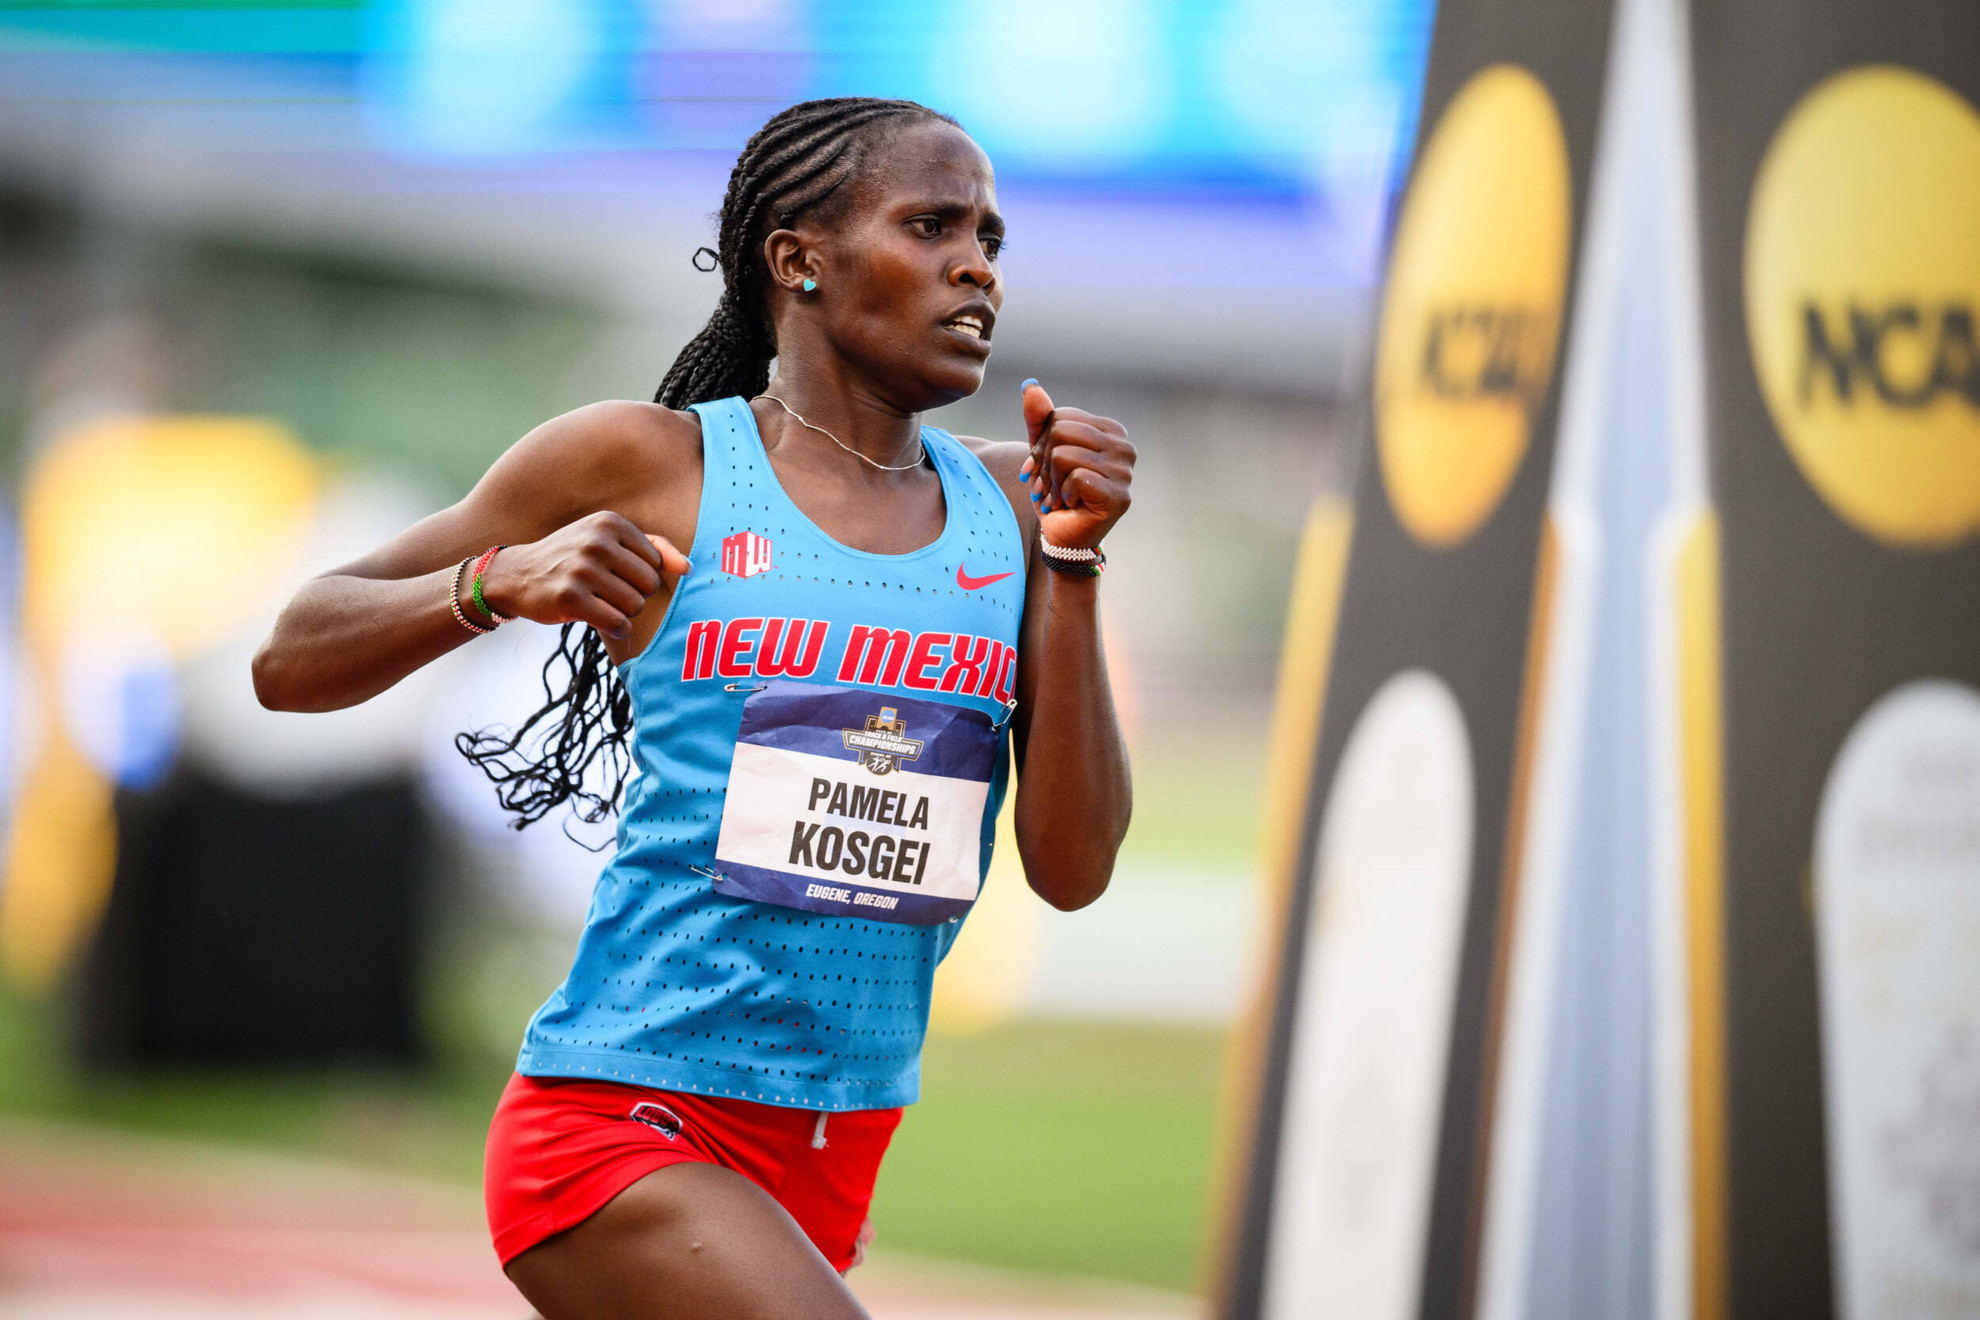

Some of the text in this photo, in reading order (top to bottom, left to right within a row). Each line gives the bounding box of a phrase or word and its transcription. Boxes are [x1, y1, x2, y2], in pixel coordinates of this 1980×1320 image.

[681, 617, 1018, 705] NEW MEXIC
[849, 735, 916, 755] CHAMPIONSHIPS
[807, 777, 929, 830] PAMELA
[788, 820, 931, 885] KOSGEI
[805, 883, 899, 910] EUGENE, OREGON
